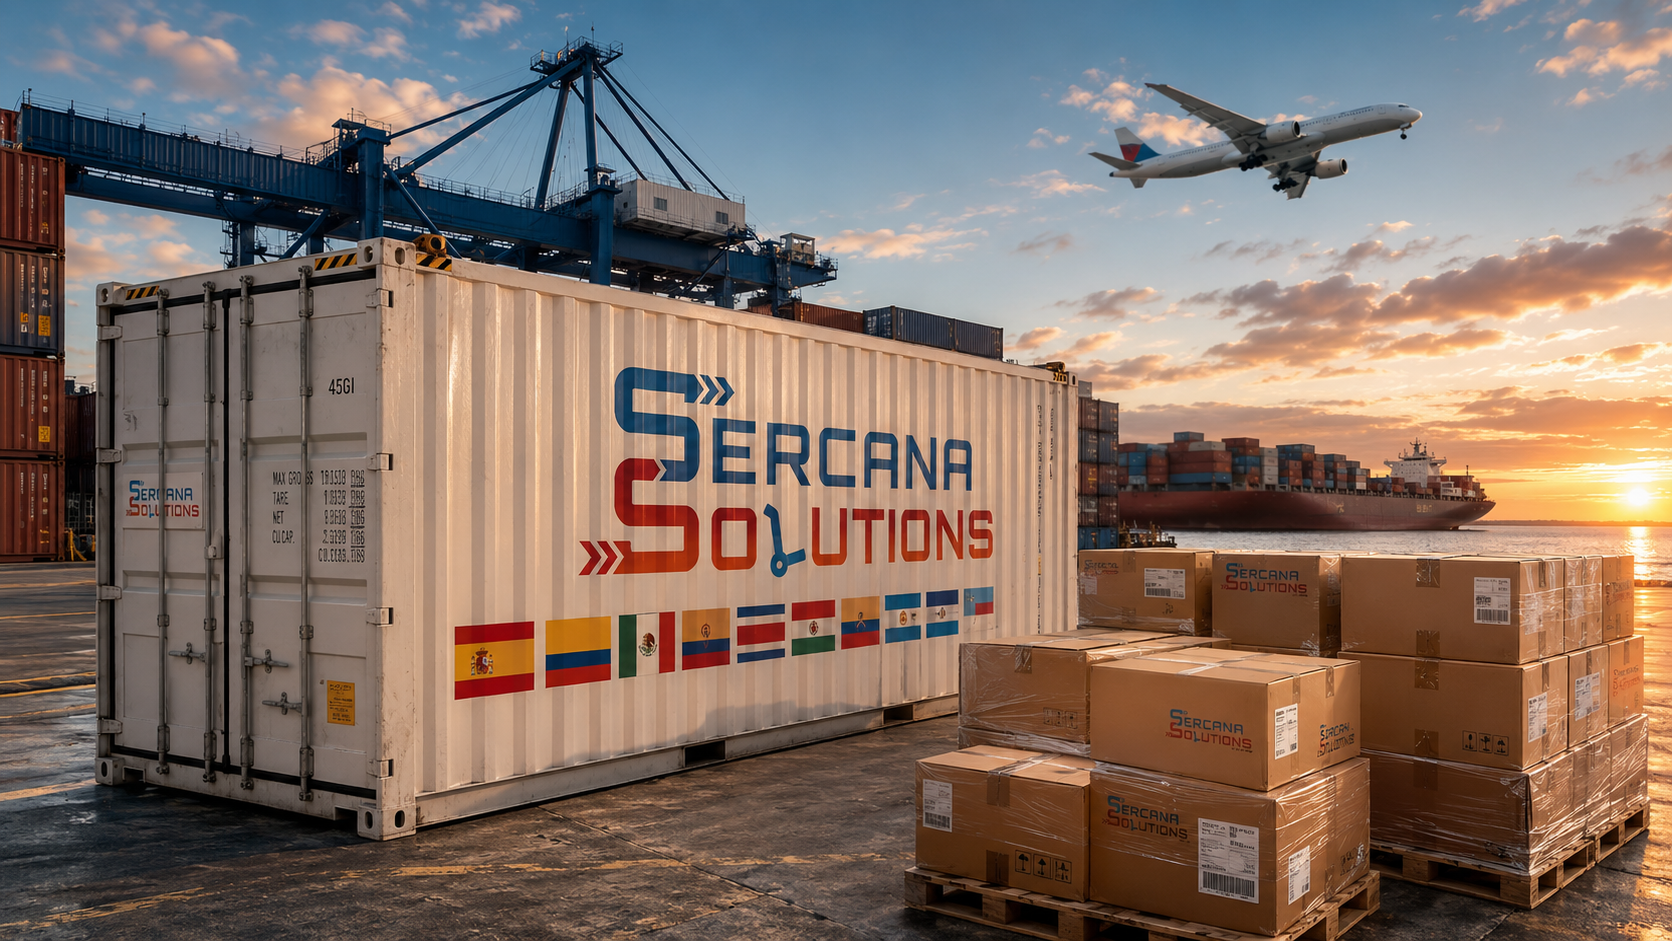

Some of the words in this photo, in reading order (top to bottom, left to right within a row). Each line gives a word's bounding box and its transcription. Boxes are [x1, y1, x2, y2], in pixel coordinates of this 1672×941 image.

[614, 366, 973, 491] SERCANA
[272, 471, 286, 486] MAX
[272, 491, 289, 506] TARE
[272, 510, 284, 525] NET
[612, 457, 994, 578] SOLUTIONS
[1225, 574, 1307, 593] SOLUTIONS
[1226, 562, 1299, 581] SERCANA
[1169, 708, 1244, 735] SERCANA
[1169, 721, 1252, 749] SOLUTIONS
[1107, 795, 1179, 825] SERCANA
[1107, 808, 1188, 840] SOLUTIONS
